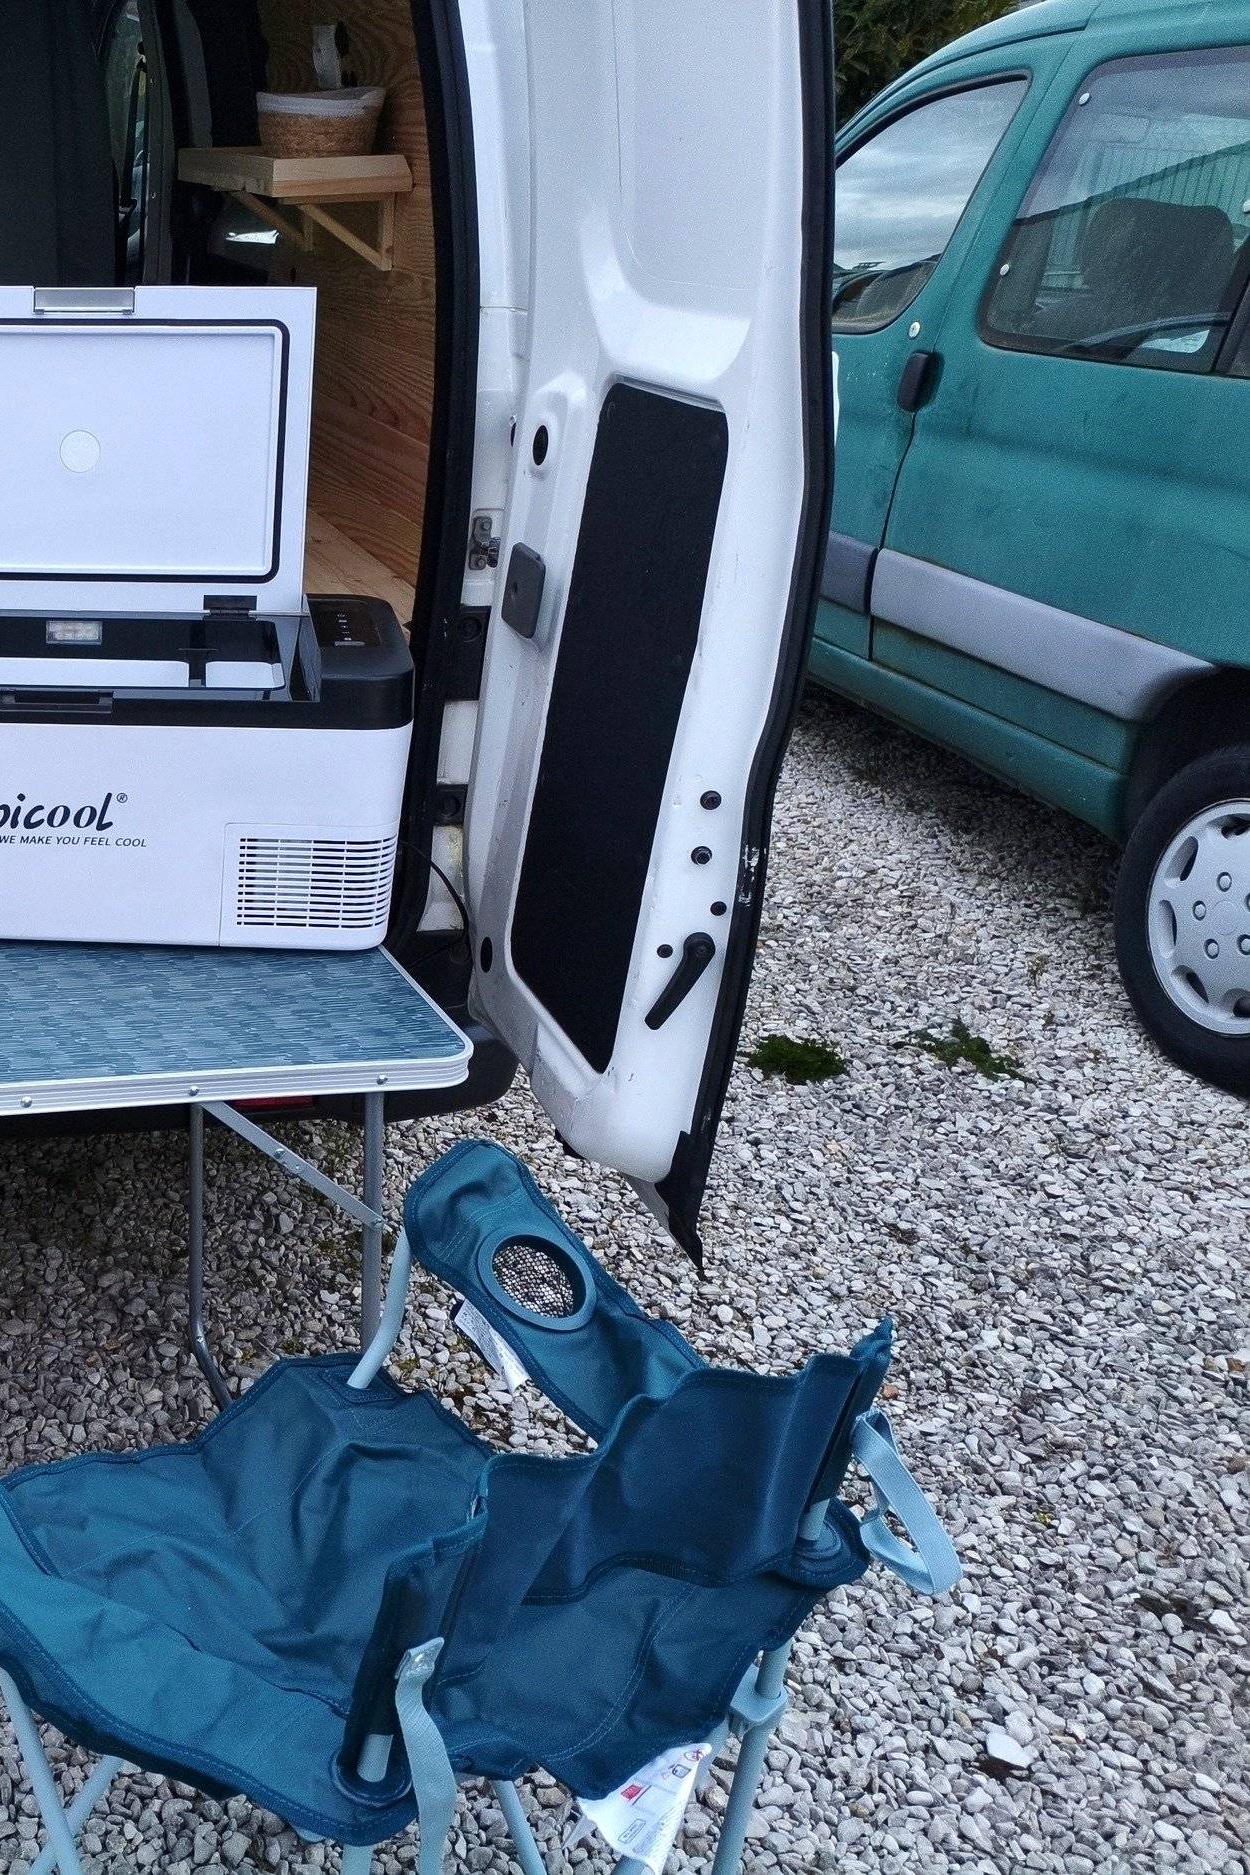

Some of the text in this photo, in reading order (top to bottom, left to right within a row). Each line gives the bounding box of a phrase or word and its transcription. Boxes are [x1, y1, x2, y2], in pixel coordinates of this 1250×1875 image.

[0, 835, 148, 848] WE MAKE YOU FEEL COOL
